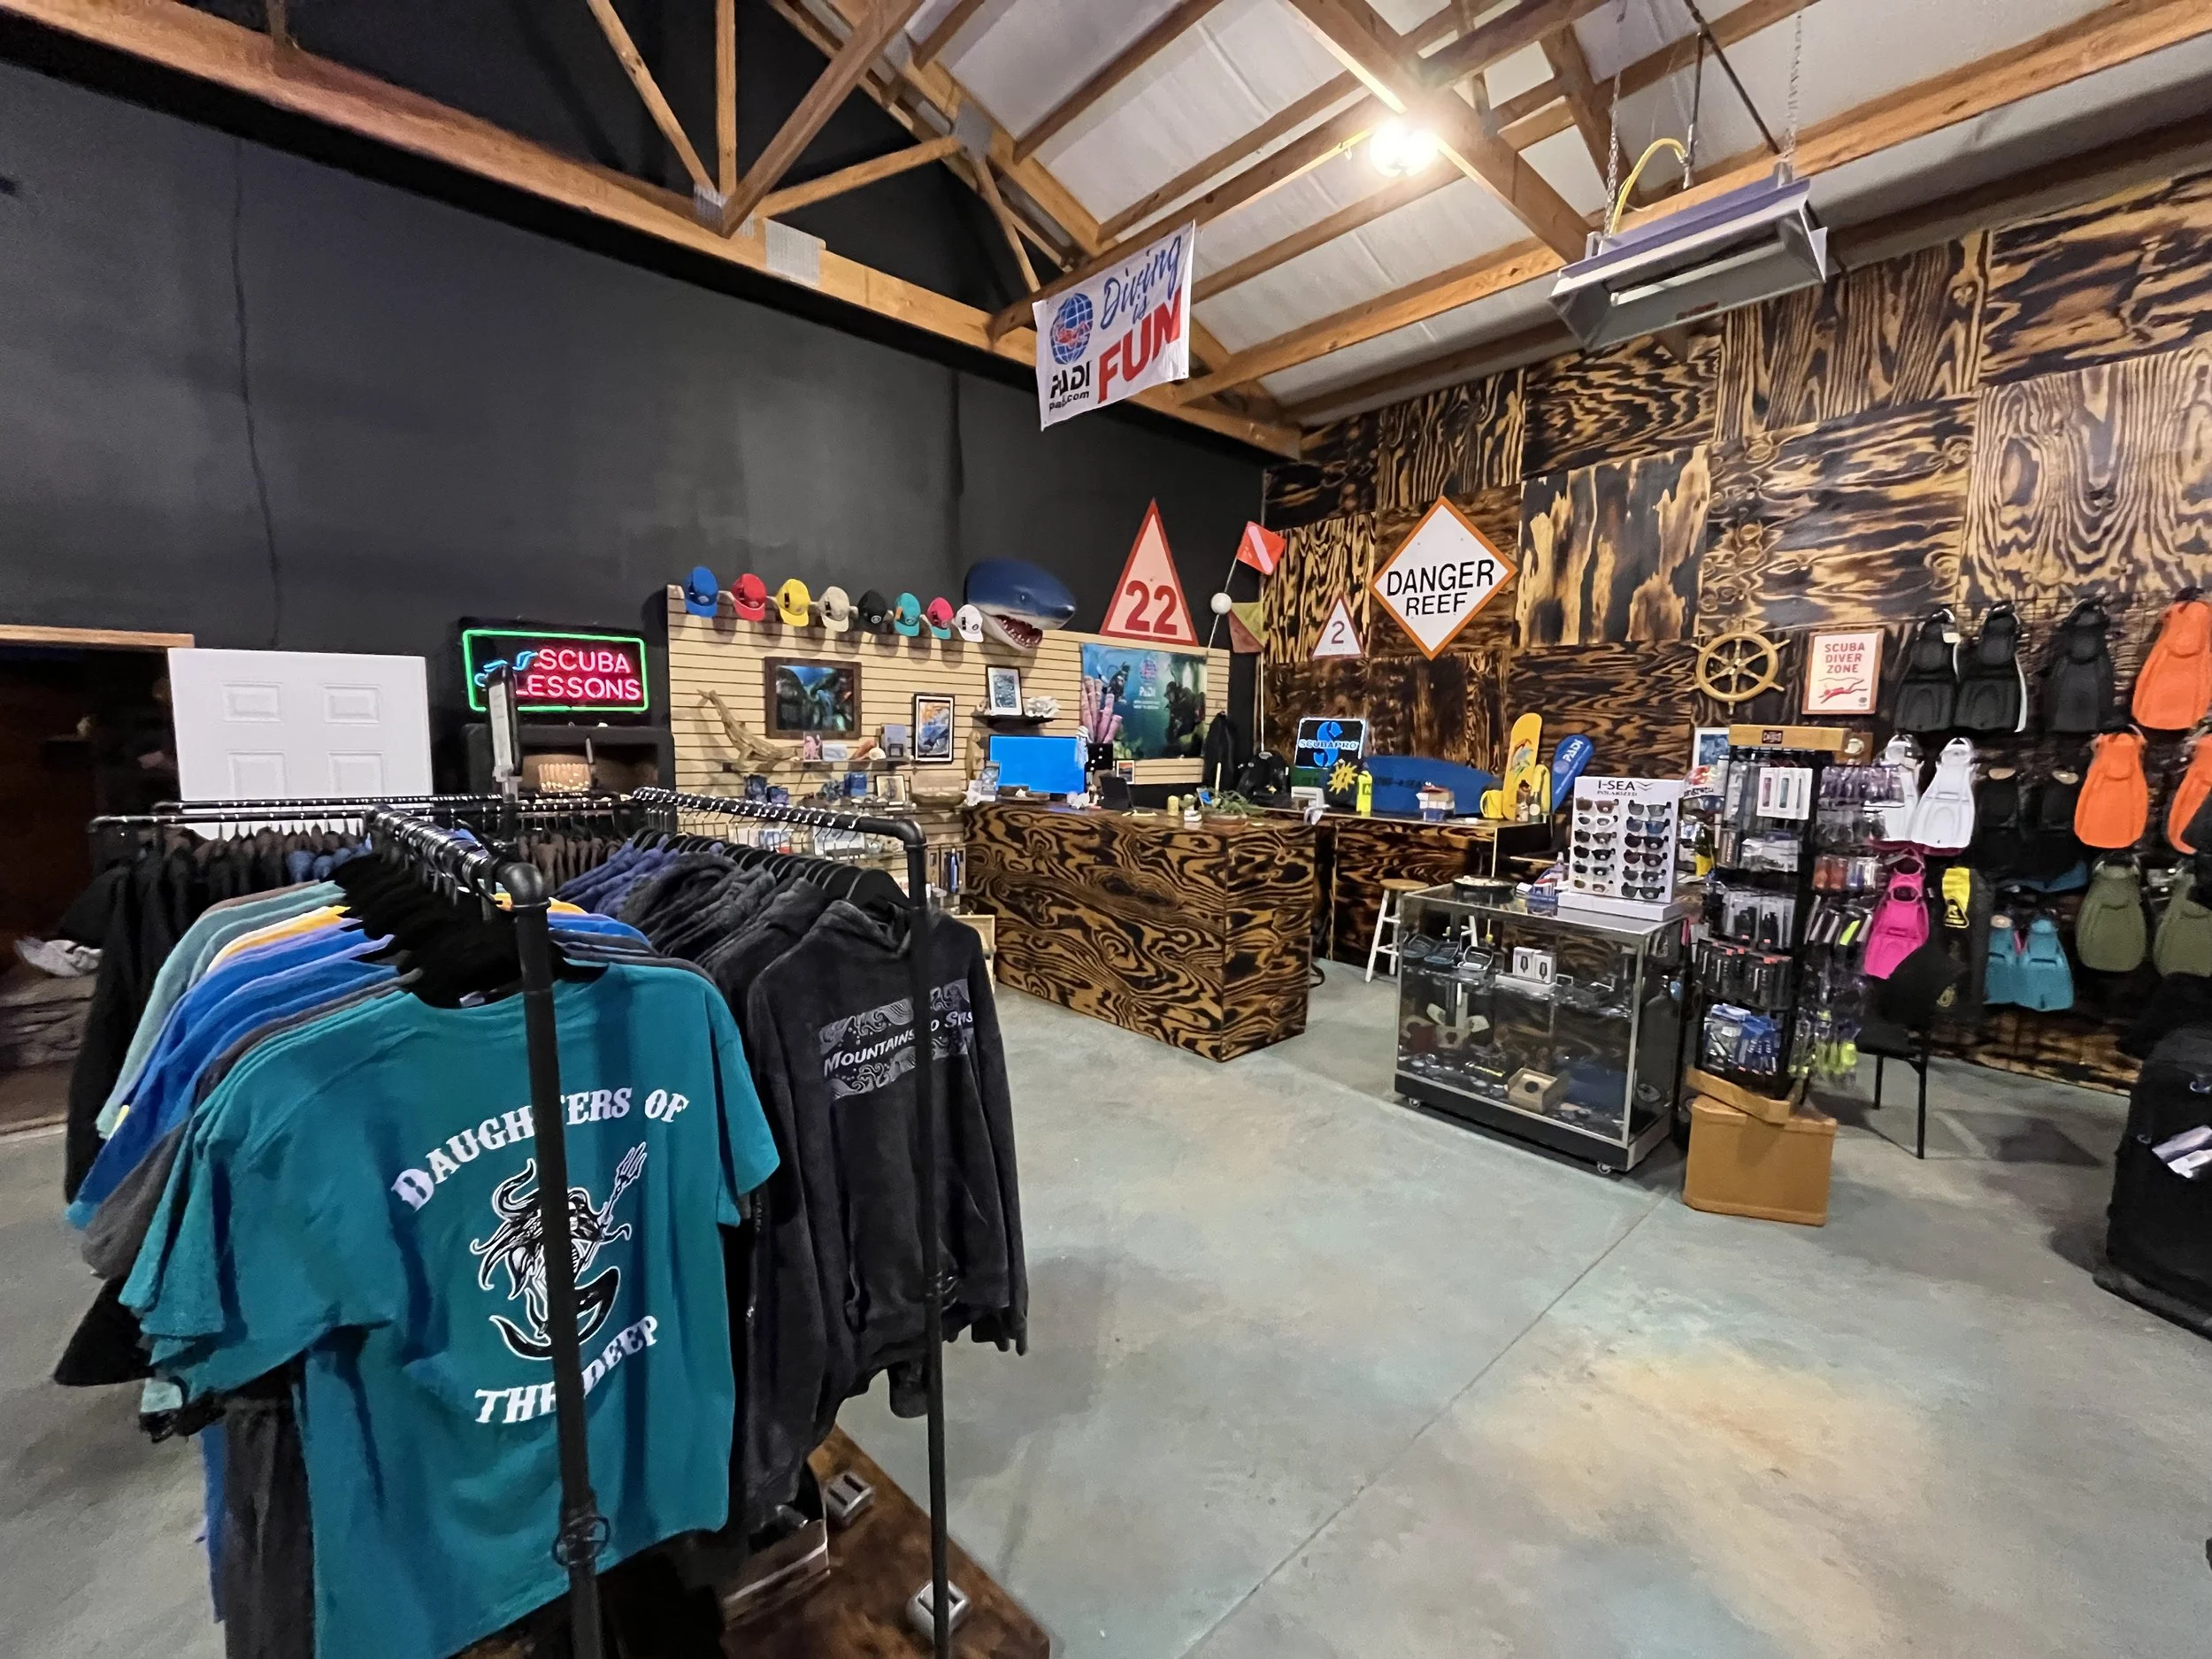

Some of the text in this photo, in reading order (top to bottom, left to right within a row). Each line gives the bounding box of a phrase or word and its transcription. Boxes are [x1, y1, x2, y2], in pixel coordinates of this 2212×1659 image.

[1101, 234, 1182, 330] Diving
[1133, 296, 1149, 325] is
[1098, 283, 1182, 404] FUN
[1050, 360, 1091, 398] PADI
[1386, 559, 1495, 596] DANGER
[1125, 580, 1178, 635] 22
[1406, 592, 1468, 616] REEF
[1331, 621, 1346, 644] 2
[1824, 642, 1865, 653] SCUBA
[1825, 653, 1863, 663] DIVER
[535, 649, 632, 673] SCUBA
[1826, 664, 1859, 673] ZONE
[1298, 739, 1359, 750] SCUBAPRO
[1563, 738, 1584, 762] PADI
[1598, 780, 1635, 791] I-SEA
[824, 1028, 916, 1077] MOUNTAINS
[930, 1018, 940, 1032] O
[390, 1087, 690, 1213] DAUGHERS OF
[580, 1315, 658, 1399] DEEP
